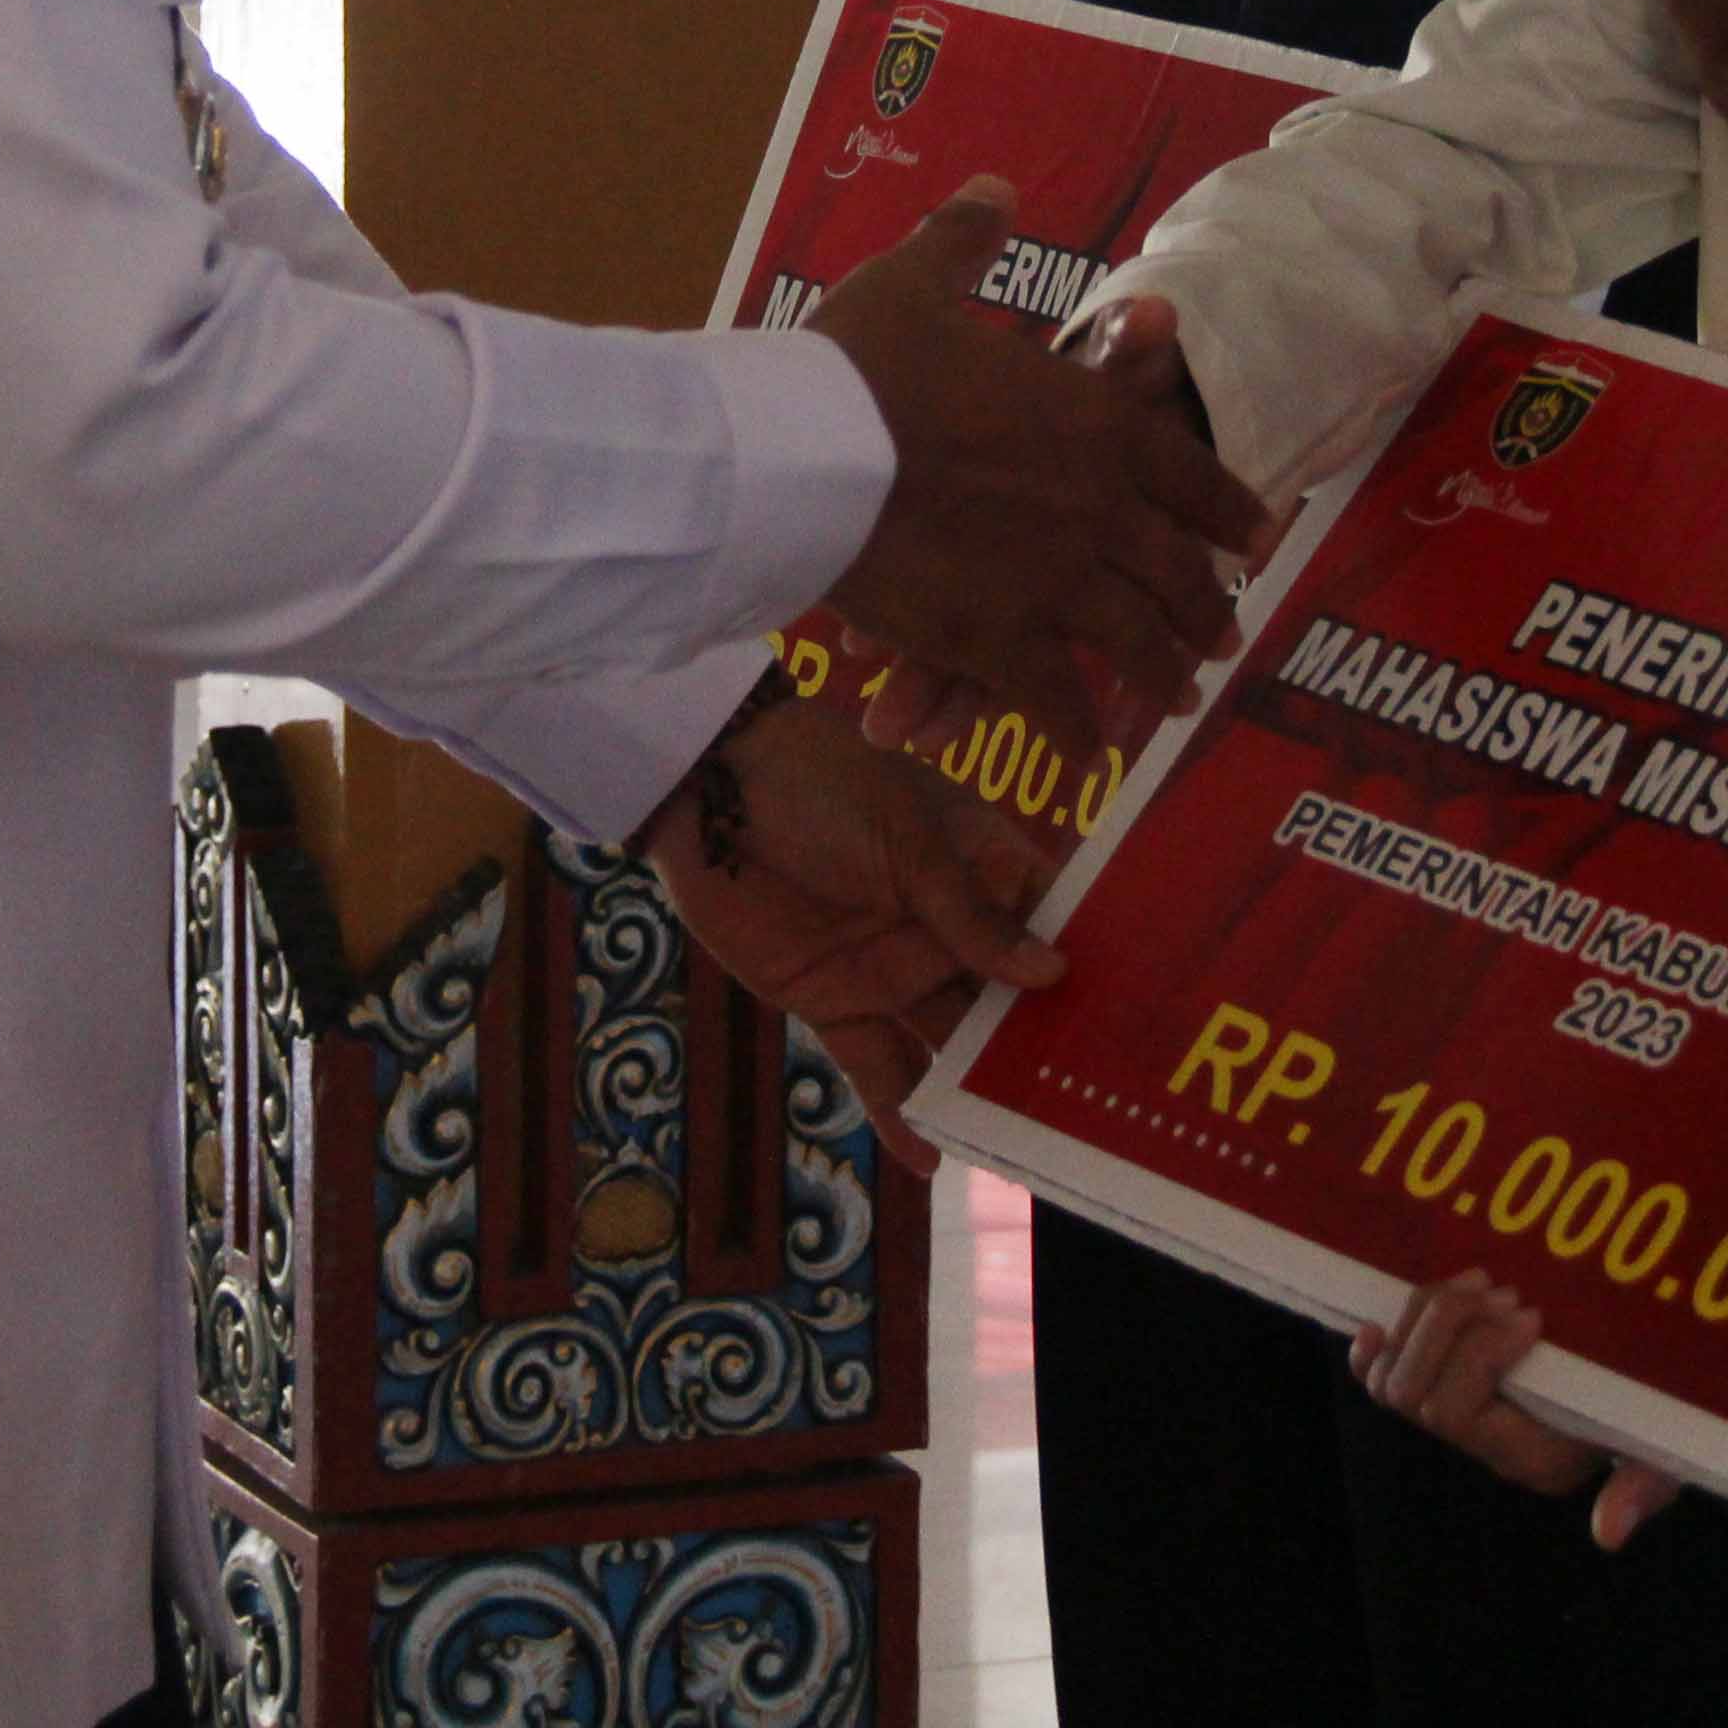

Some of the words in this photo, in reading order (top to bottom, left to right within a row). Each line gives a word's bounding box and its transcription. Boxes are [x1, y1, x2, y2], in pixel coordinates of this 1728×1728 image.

[1277, 617, 1629, 796] MAHASISWA
[1277, 794, 1600, 951] PEMERINTAH
[1167, 1001, 1336, 1145] RP.
[1557, 980, 1688, 1065] 2023
